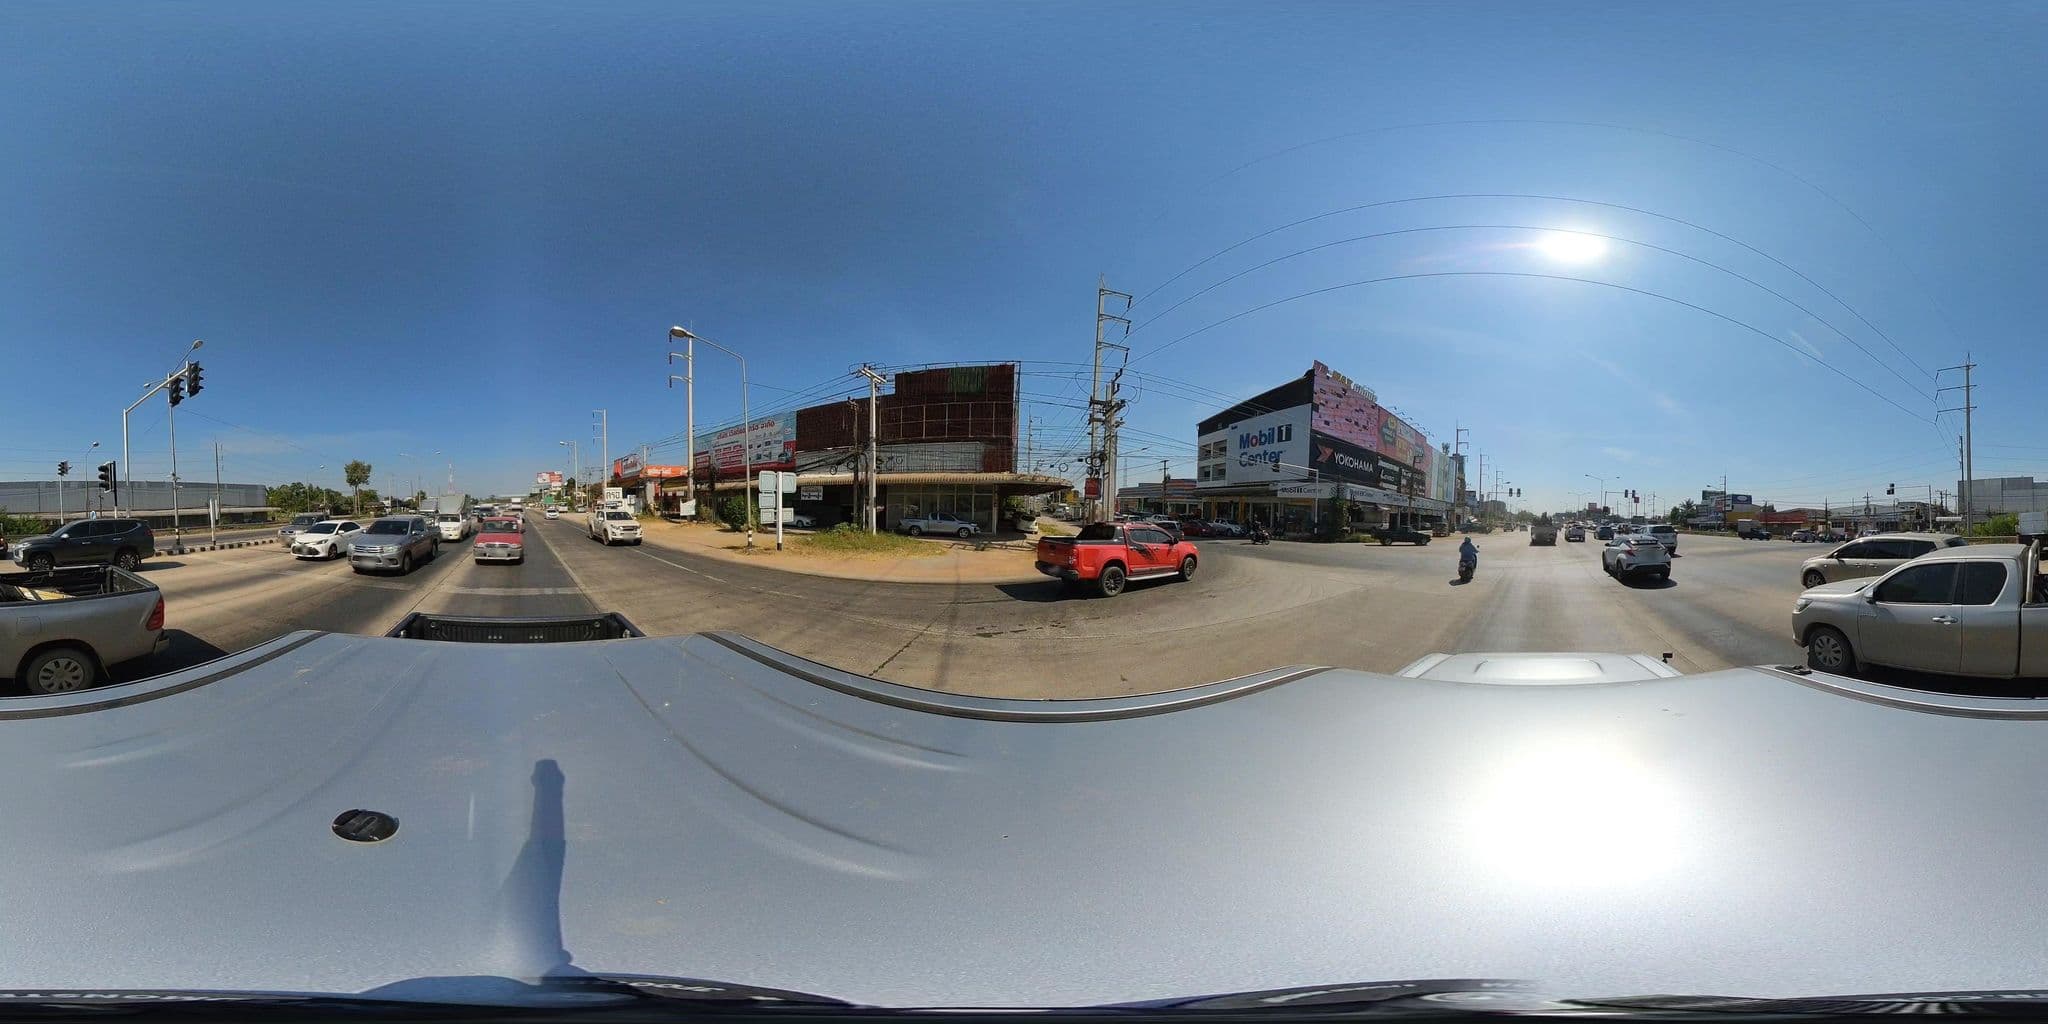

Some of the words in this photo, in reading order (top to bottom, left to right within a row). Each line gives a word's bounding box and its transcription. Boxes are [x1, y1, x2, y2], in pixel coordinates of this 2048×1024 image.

[1239, 427, 1275, 449] Mobil
[1239, 450, 1283, 467] Center
[1334, 452, 1374, 472] YOKOHAMA
